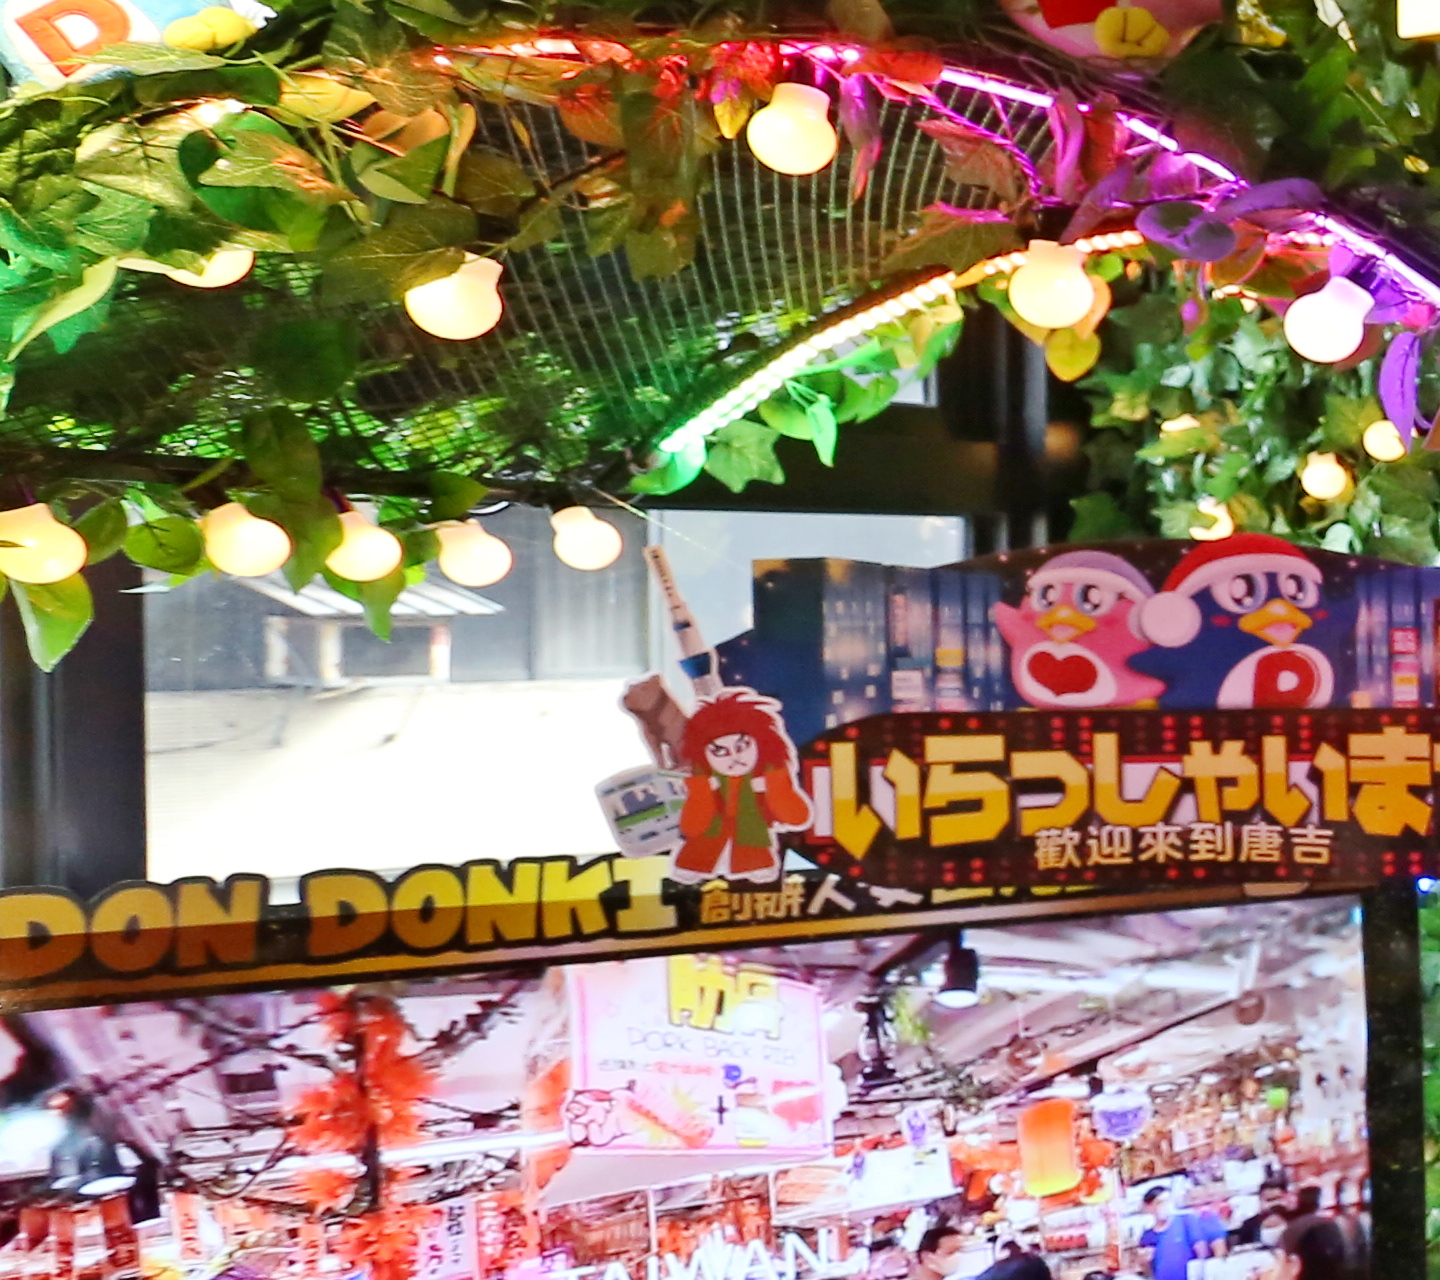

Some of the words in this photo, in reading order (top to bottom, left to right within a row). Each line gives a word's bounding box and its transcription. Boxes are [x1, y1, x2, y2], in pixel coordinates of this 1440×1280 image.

[1035, 822, 1332, 870] 歡迎來到唐吉
[0, 894, 262, 977] DON
[299, 860, 678, 960] DONKI
